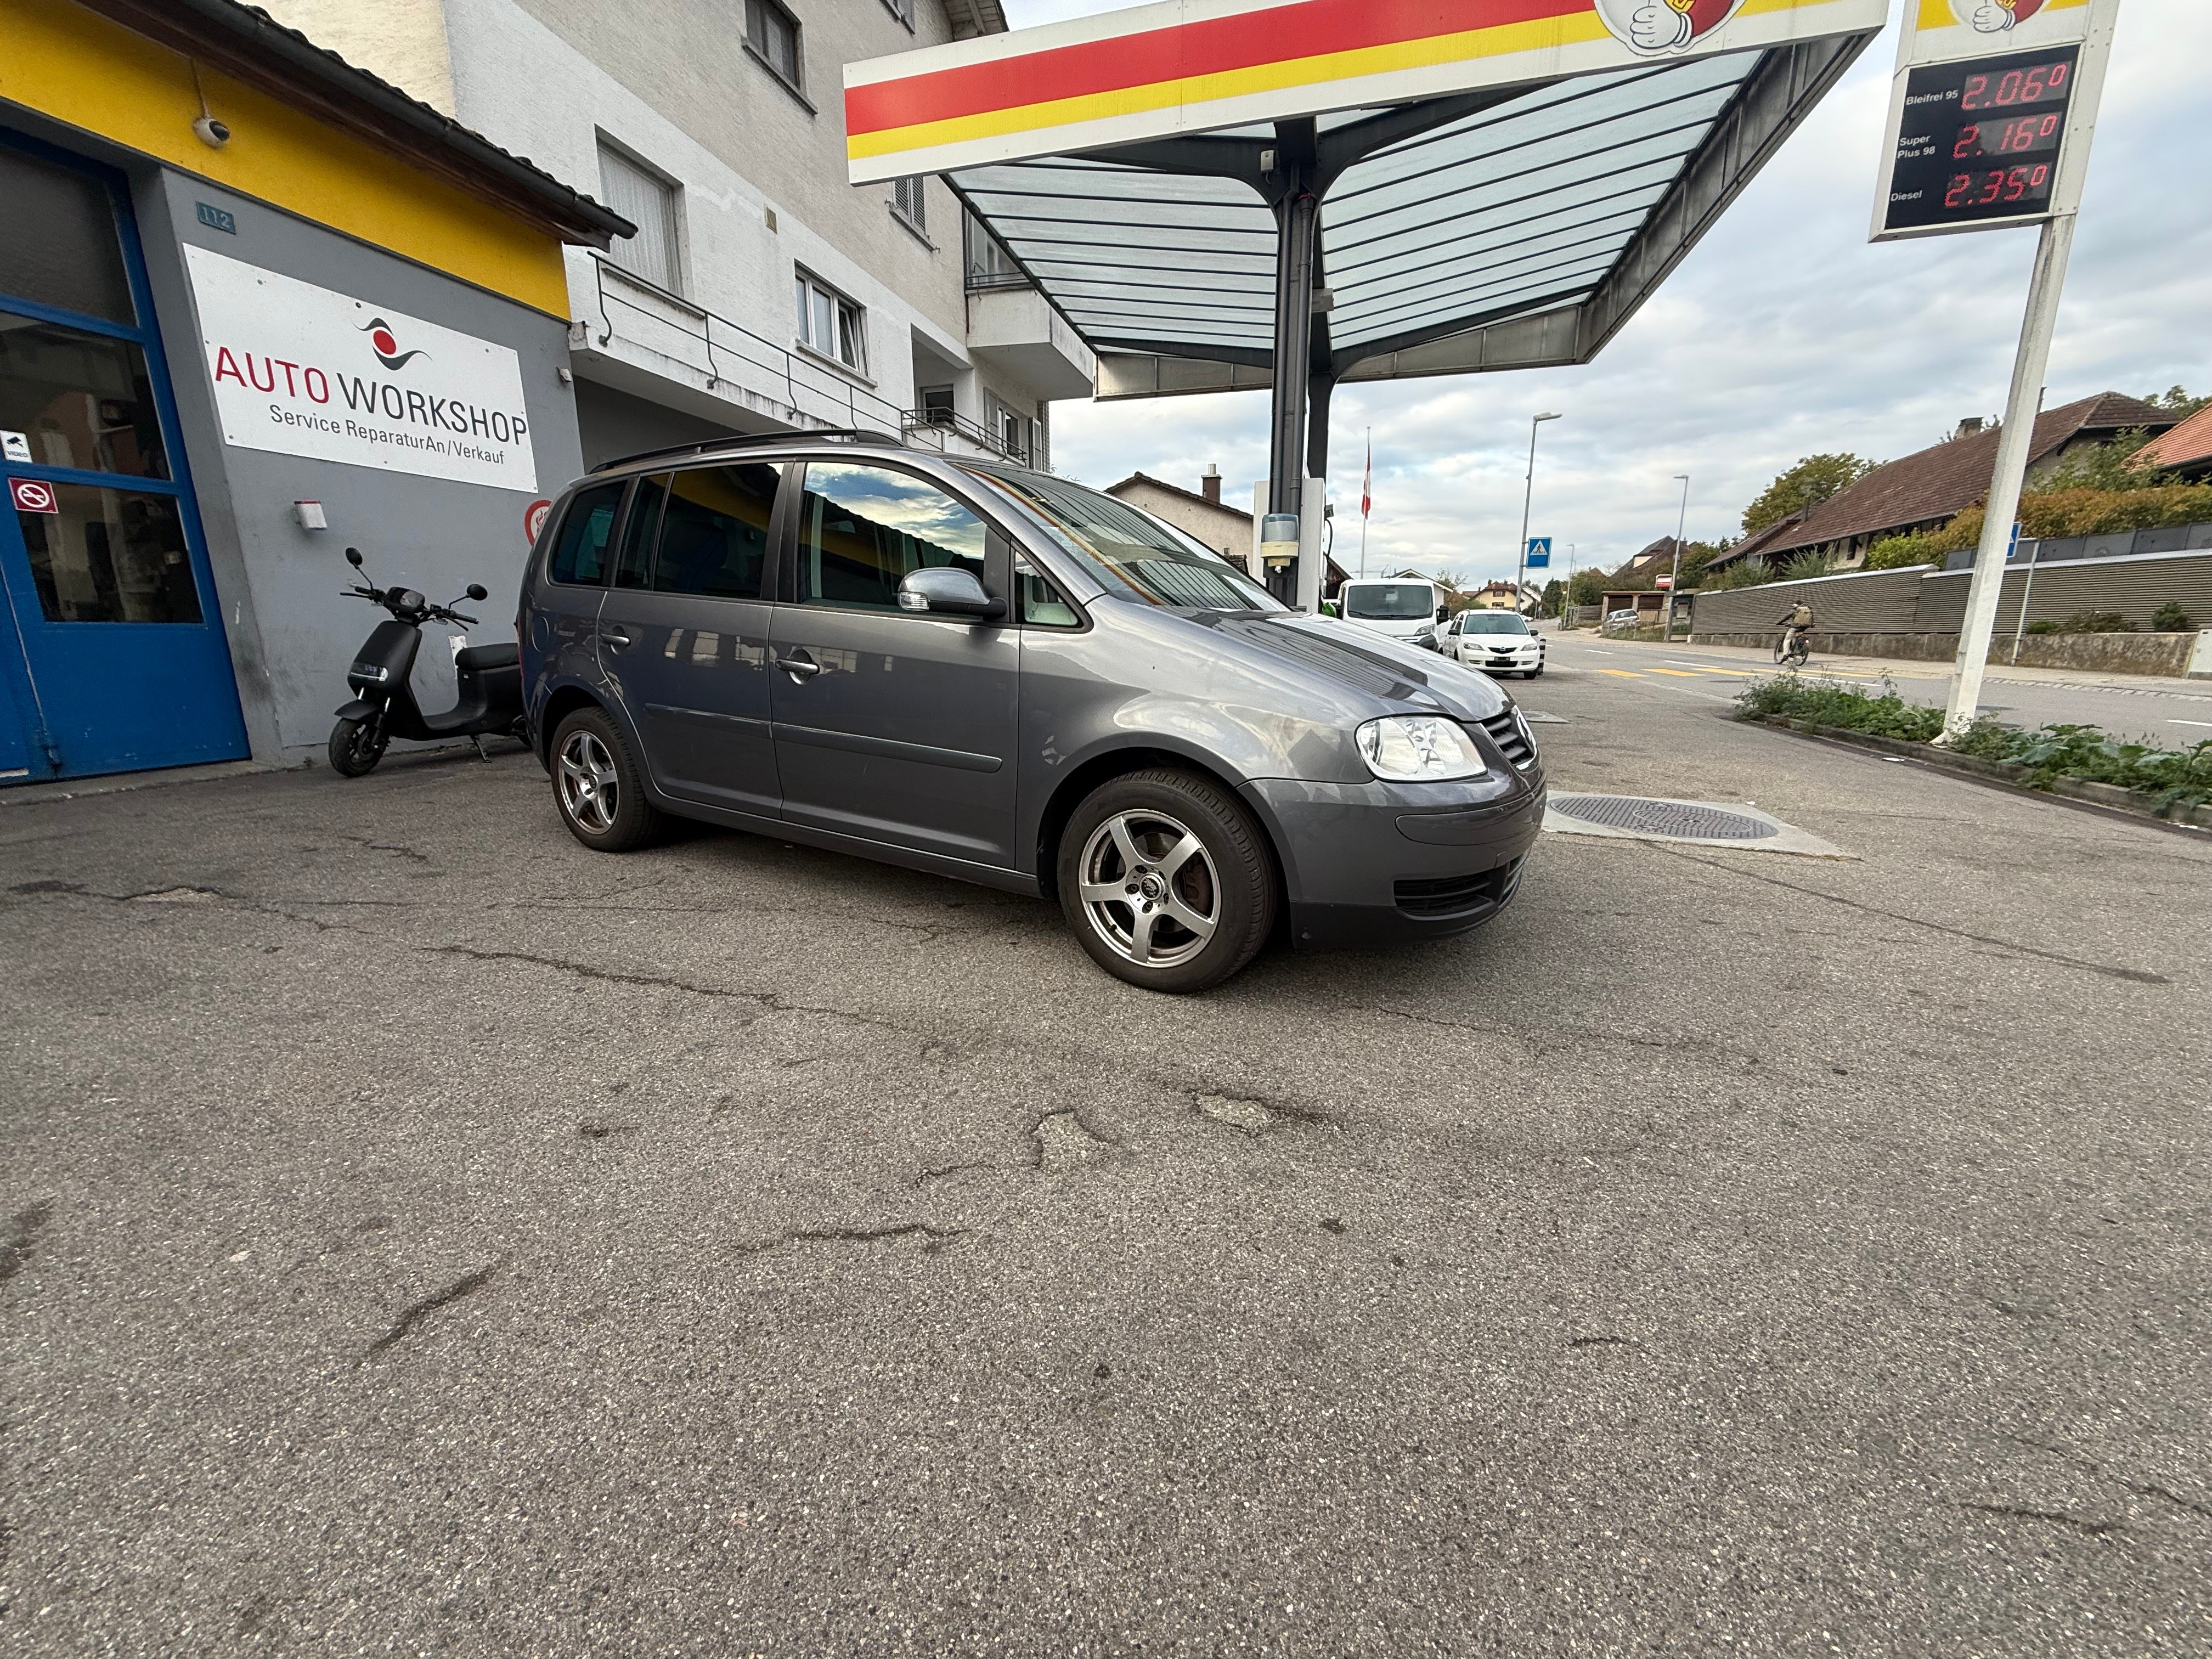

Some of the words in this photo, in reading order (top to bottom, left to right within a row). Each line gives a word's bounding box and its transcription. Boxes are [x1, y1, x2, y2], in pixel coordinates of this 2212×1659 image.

[1906, 92, 1944, 105] Bleifrei
[1945, 89, 1959, 99] 95
[1899, 136, 1931, 146] Super
[1898, 149, 1921, 159] Plus
[1923, 145, 1936, 155] 98
[1891, 190, 1923, 201] Diesel
[202, 206, 230, 229] 112
[215, 346, 330, 404] AUTO
[336, 373, 527, 445] WORKSHOP
[270, 404, 341, 434] Service
